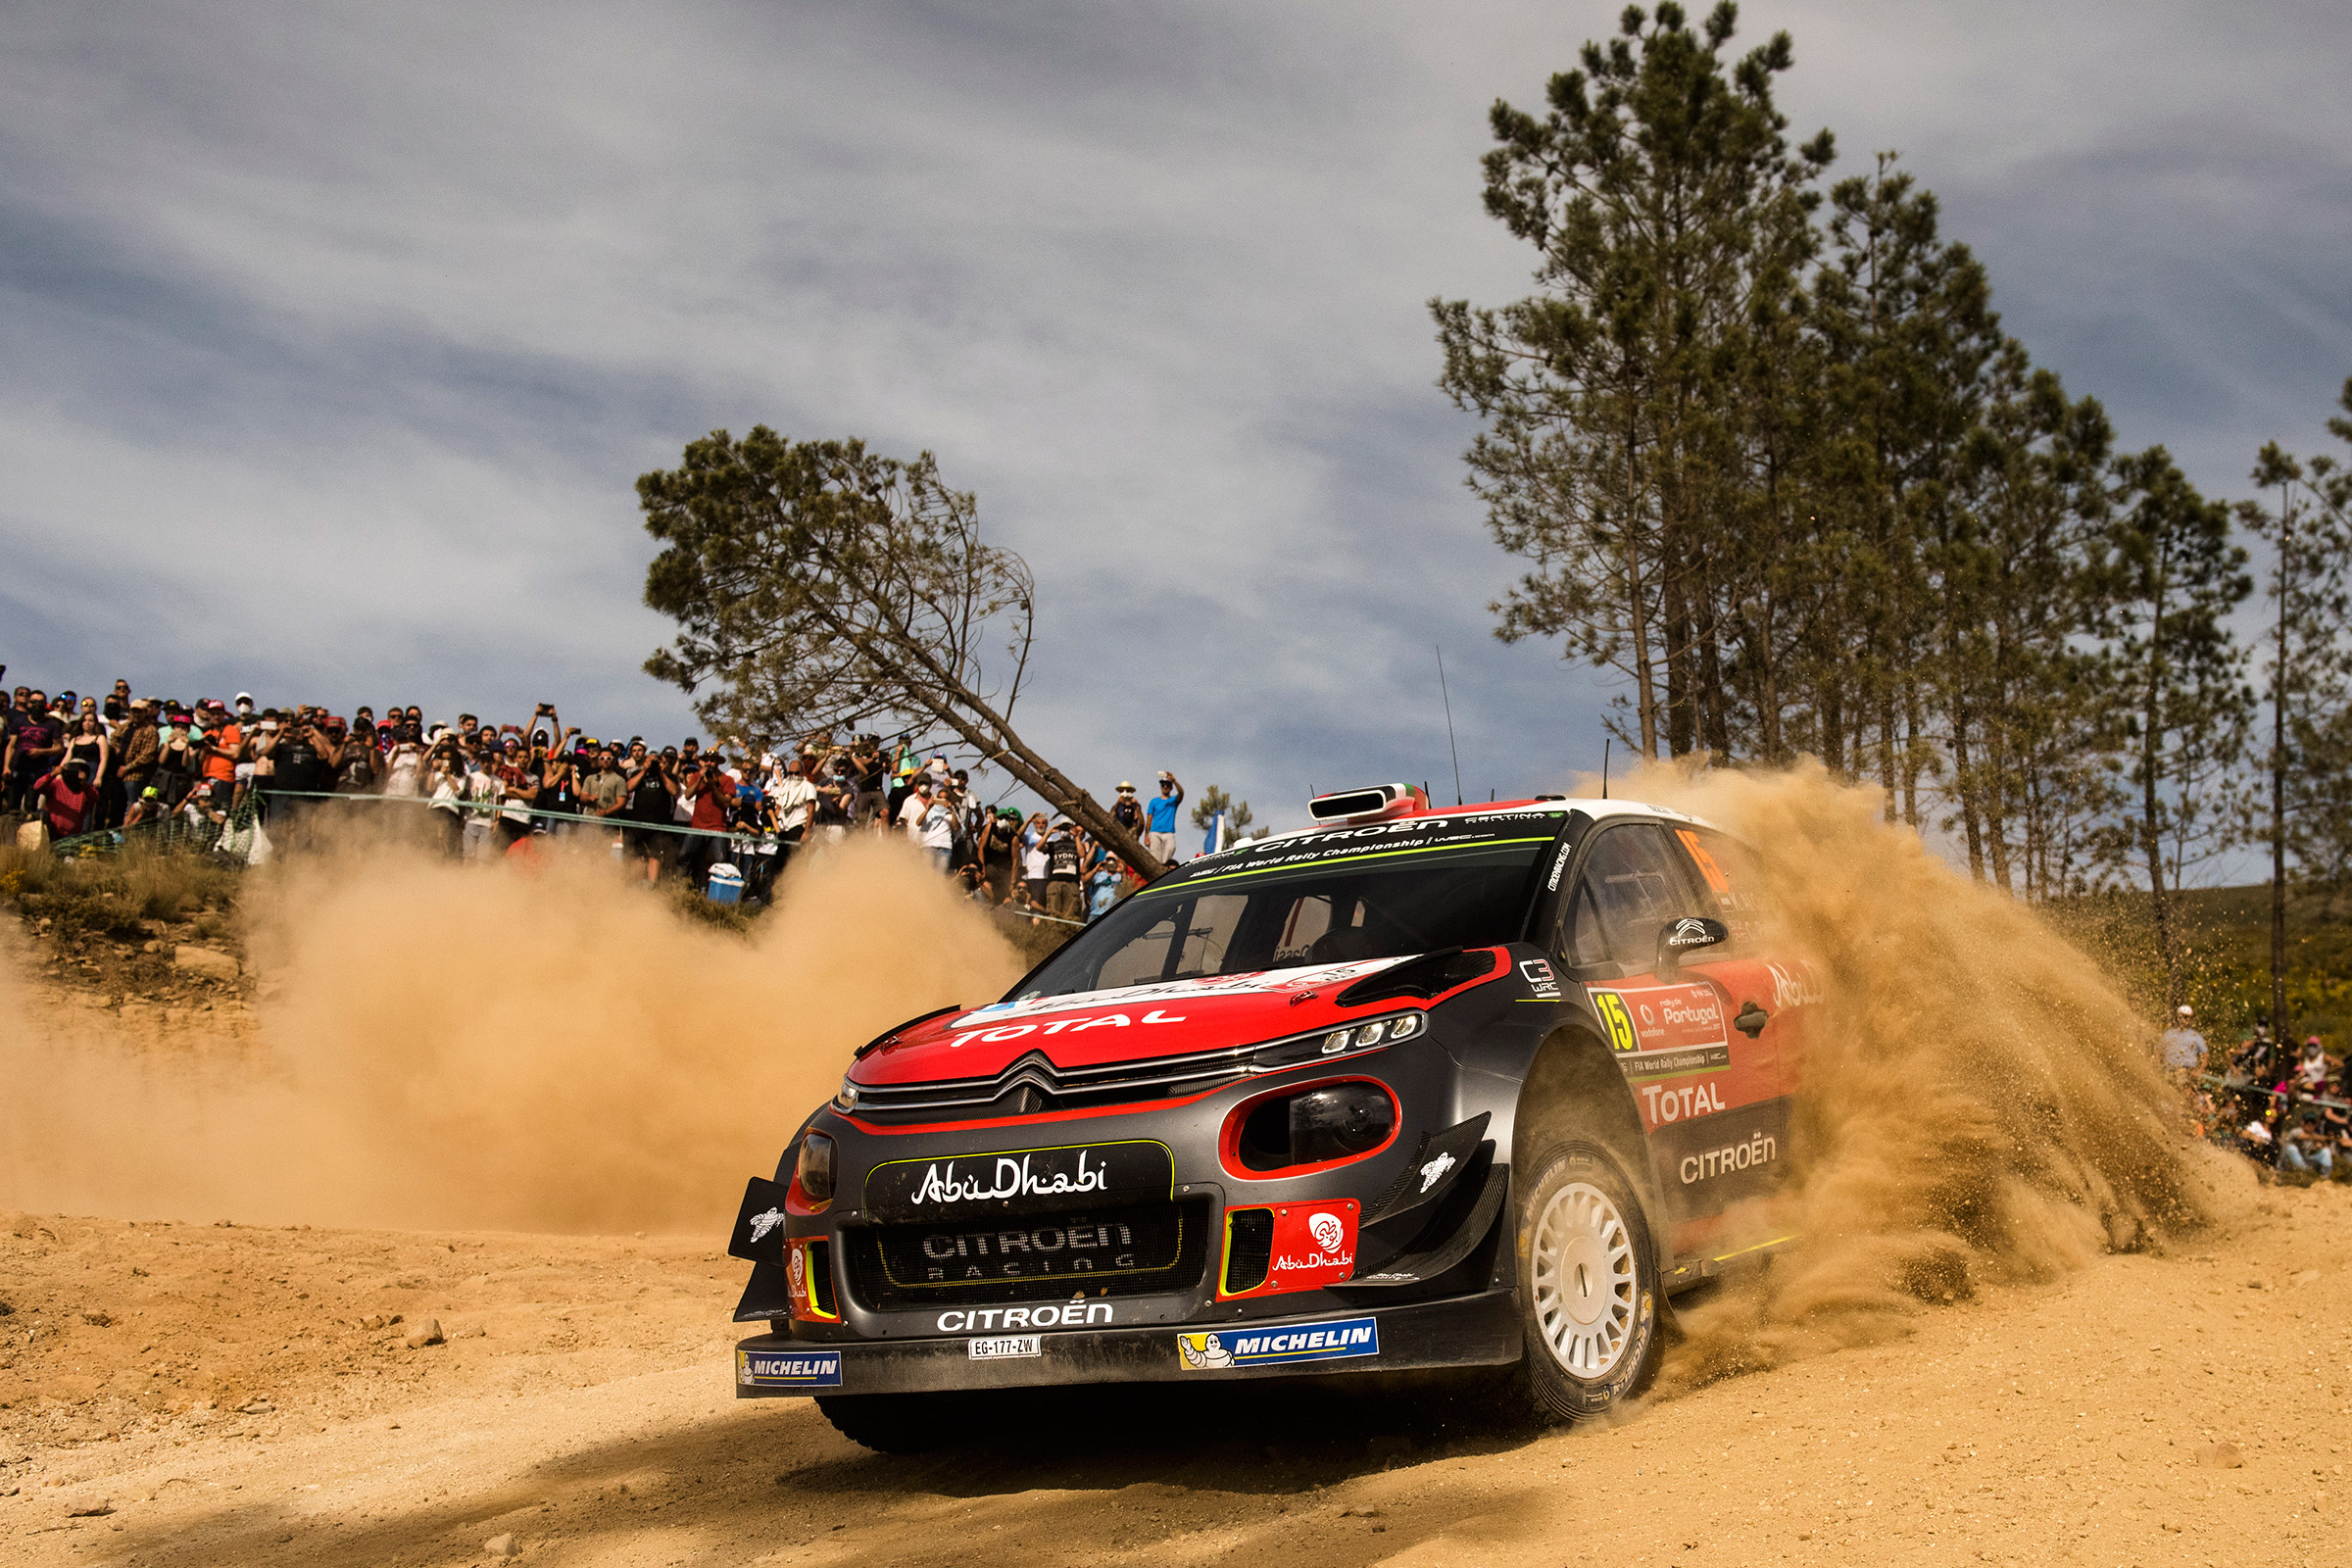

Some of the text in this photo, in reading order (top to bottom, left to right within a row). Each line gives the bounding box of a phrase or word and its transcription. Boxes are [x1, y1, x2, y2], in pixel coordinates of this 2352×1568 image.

[1255, 819, 1448, 853] CITROËN
[1222, 862, 1244, 872] FIA
[1246, 857, 1286, 868] World
[1285, 852, 1321, 862] Rally
[1323, 837, 1424, 856] Championship
[1675, 829, 1729, 893] 15
[1519, 959, 1555, 983] C3
[1531, 983, 1560, 993] WRC
[950, 1009, 1187, 1048] TOTAL
[1596, 994, 1633, 1051] 15
[1663, 1003, 1719, 1025] Portugal
[1641, 1027, 1665, 1038] vodafone
[1635, 1061, 1644, 1071] FIA
[1644, 1059, 1660, 1071] World
[1660, 1057, 1673, 1069] Rally
[1673, 1054, 1705, 1067] Championship
[1642, 1082, 1726, 1124] TOTAL
[1680, 1132, 1776, 1185] CITROËN
[936, 1299, 1114, 1332] CITROËN
[974, 1339, 1034, 1355] EG-177-ZW
[1234, 1327, 1372, 1354] MICHELIN
[754, 1359, 837, 1375] MICHELIN
